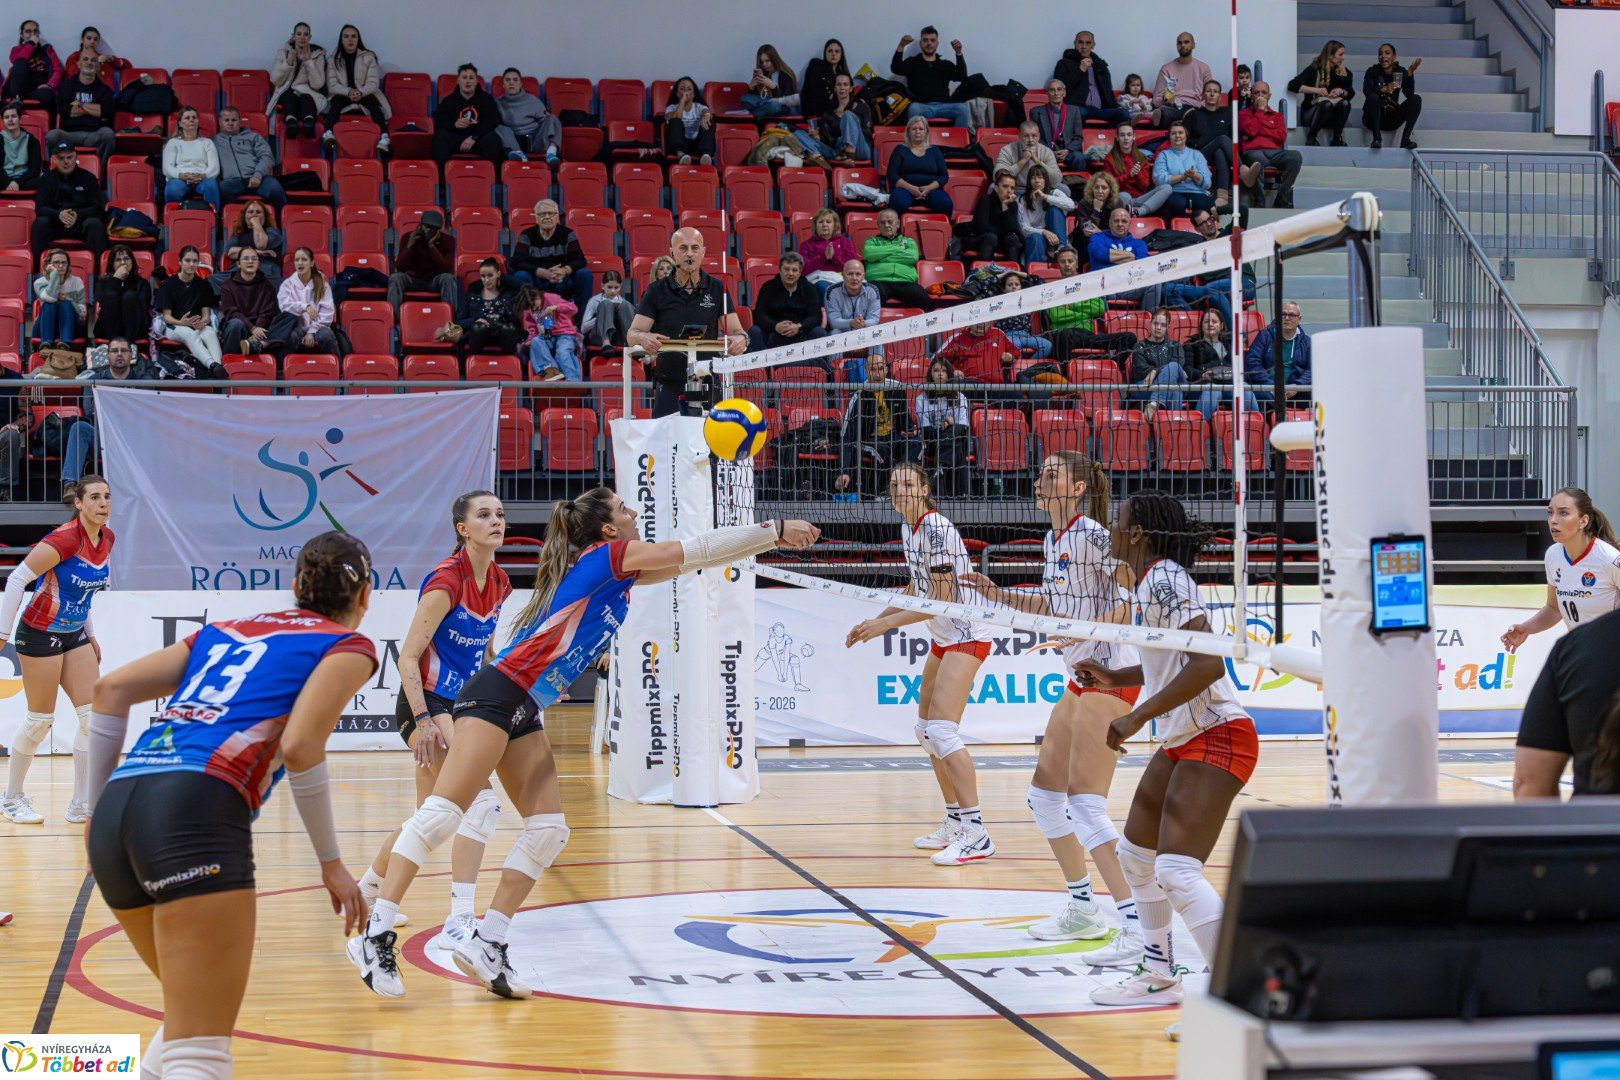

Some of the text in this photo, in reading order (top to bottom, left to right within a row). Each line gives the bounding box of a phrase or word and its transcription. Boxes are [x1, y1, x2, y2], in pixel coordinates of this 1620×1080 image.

[1562, 600, 1580, 623] 10
[178, 641, 268, 704] 13
[1454, 653, 1516, 691] ad!
[641, 640, 667, 770] TippmixPRO
[720, 640, 743, 770] TippmixPRO
[769, 696, 796, 711] 2026
